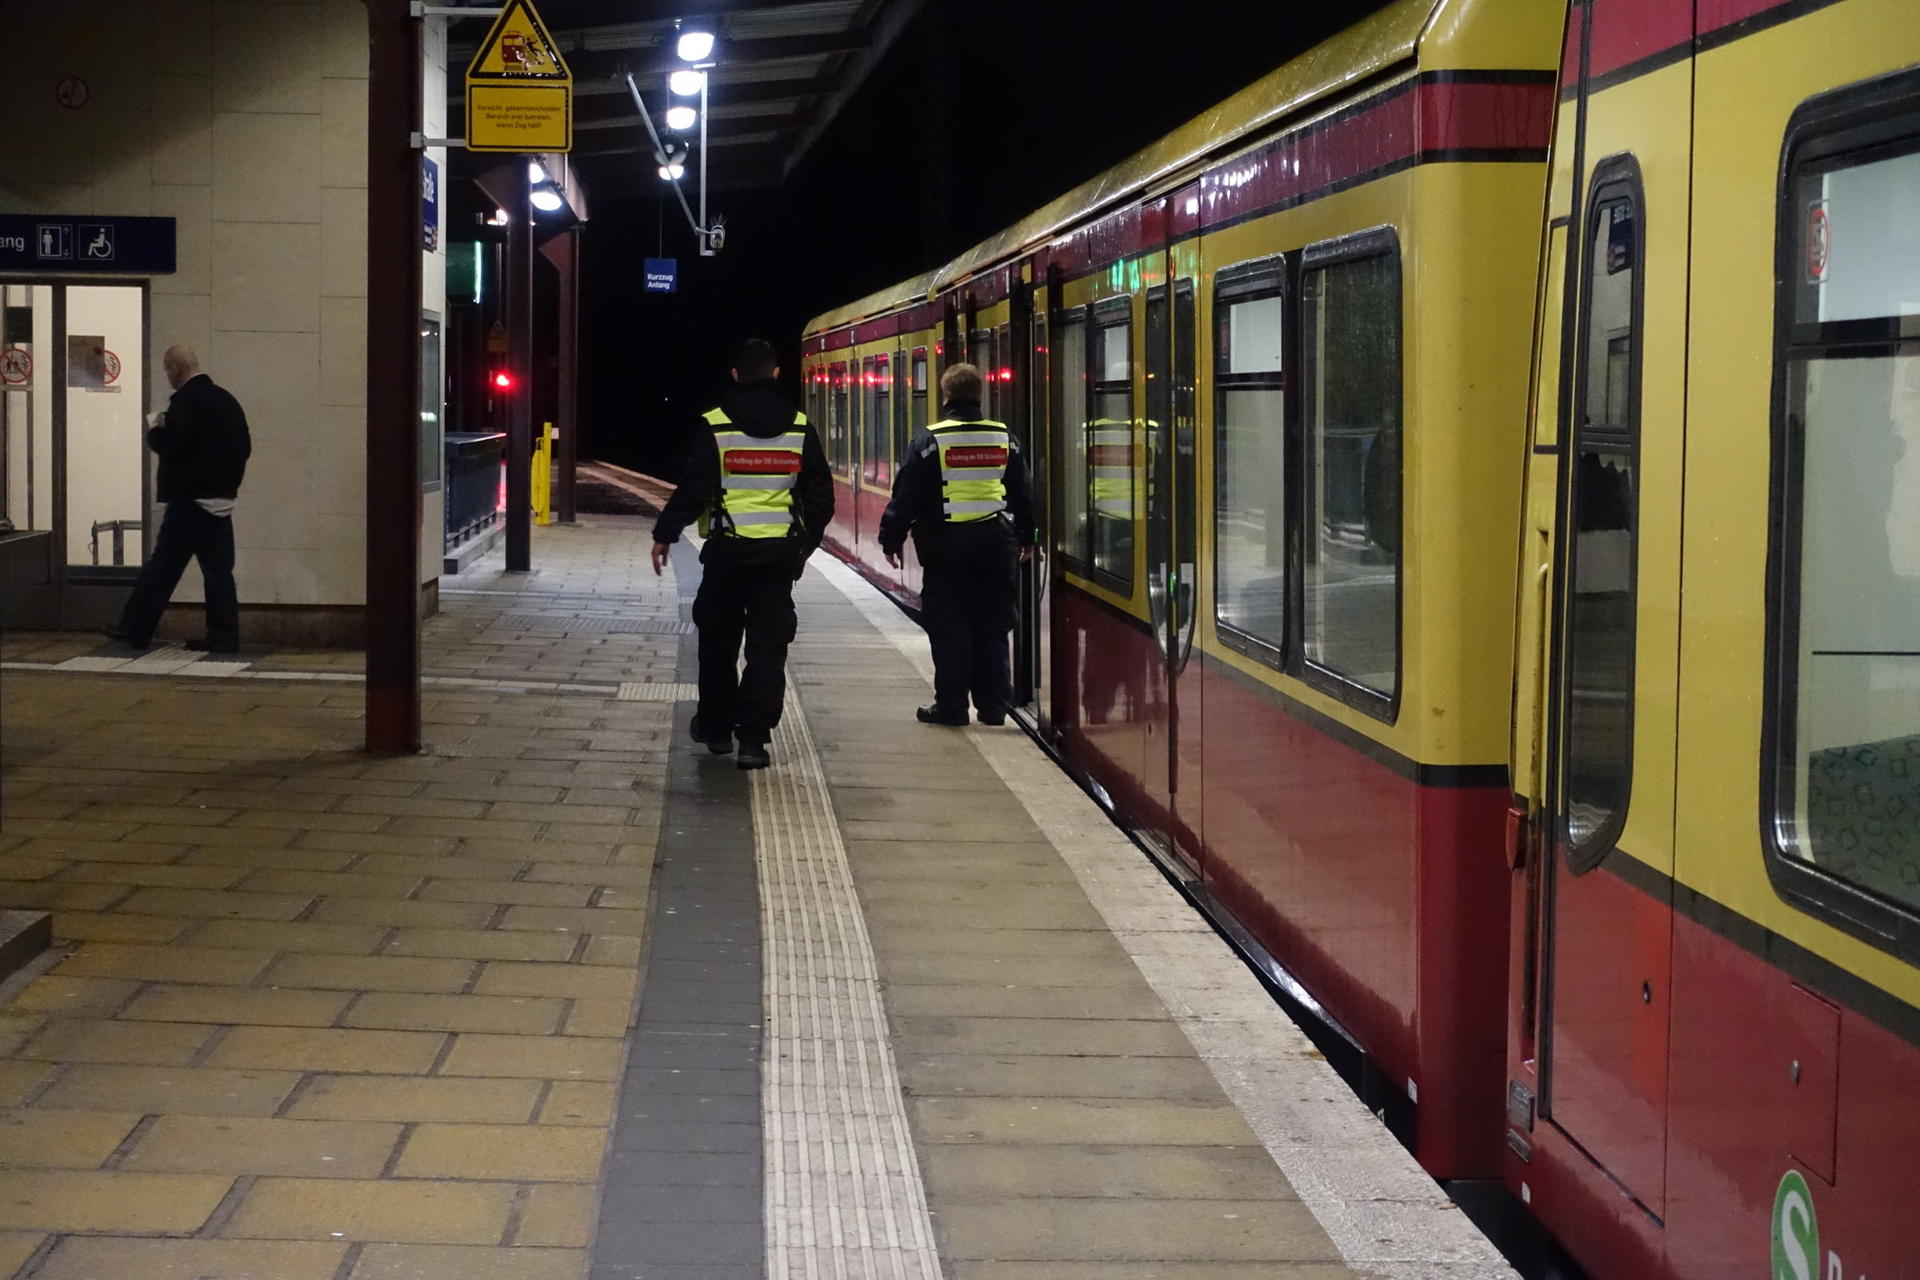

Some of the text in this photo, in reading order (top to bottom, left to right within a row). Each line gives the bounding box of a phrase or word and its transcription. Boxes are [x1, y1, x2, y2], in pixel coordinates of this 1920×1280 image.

[515, 121, 527, 130] Zug
[647, 273, 673, 281] Kurzzug
[647, 281, 670, 289] Anfang
[733, 457, 753, 466] Auftrag
[773, 457, 800, 465] Sicherheit
